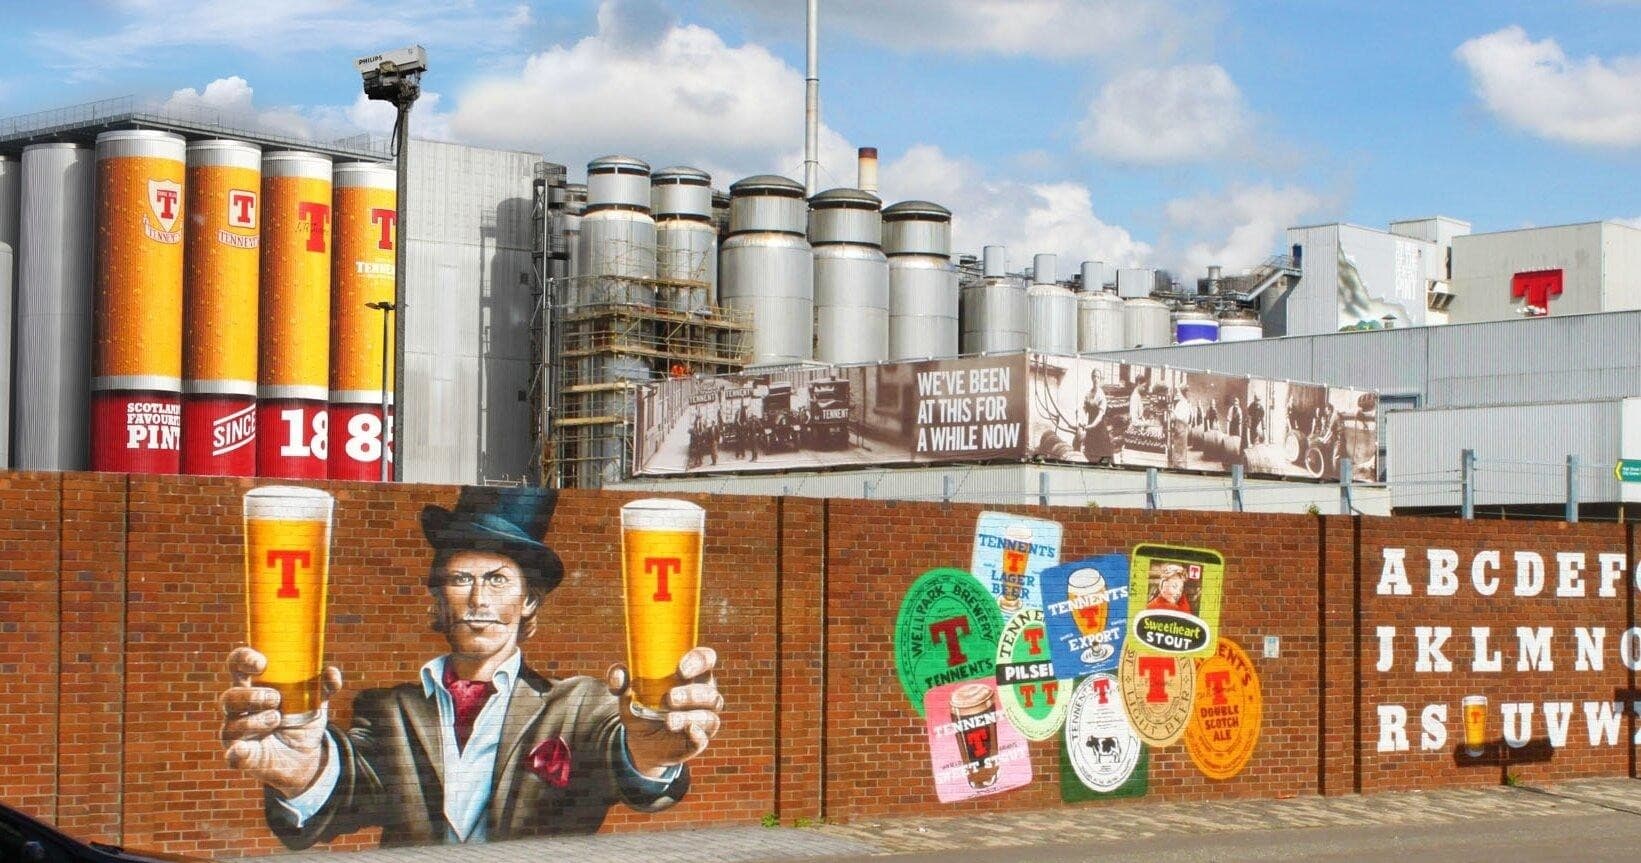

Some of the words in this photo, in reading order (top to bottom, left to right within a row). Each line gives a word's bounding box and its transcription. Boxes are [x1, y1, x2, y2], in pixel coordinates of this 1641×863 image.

[358, 55, 383, 65] PHILIPS
[233, 194, 255, 224] T
[298, 201, 330, 253] T
[371, 208, 398, 250] T
[1511, 269, 1563, 316] T
[917, 370, 966, 397] WE'VE
[969, 367, 1011, 394] BEEN
[917, 400, 936, 425] AT
[937, 397, 973, 424] THIS
[975, 395, 1008, 421] FOR
[213, 410, 256, 448] SINCE
[916, 427, 928, 452] A
[929, 425, 979, 451] WHILE
[981, 422, 1021, 450] NOW
[266, 549, 310, 599] T
[644, 557, 681, 602] T
[990, 570, 1035, 587] LAGER
[991, 583, 1030, 599] BEER
[911, 586, 946, 658] WELLPARK
[953, 583, 994, 642] BREWERY
[1144, 618, 1200, 639] Sweetheart
[928, 615, 970, 667] T
[1023, 628, 1044, 654] T
[1068, 627, 1120, 652] EXPORT
[1146, 631, 1192, 649] STOUT
[1093, 678, 1109, 704] T
[1138, 657, 1175, 702] T
[1200, 705, 1239, 718] DOUBLE
[1205, 719, 1239, 731] SCOTCH
[966, 730, 988, 758] T
[1213, 731, 1231, 742] ALE
